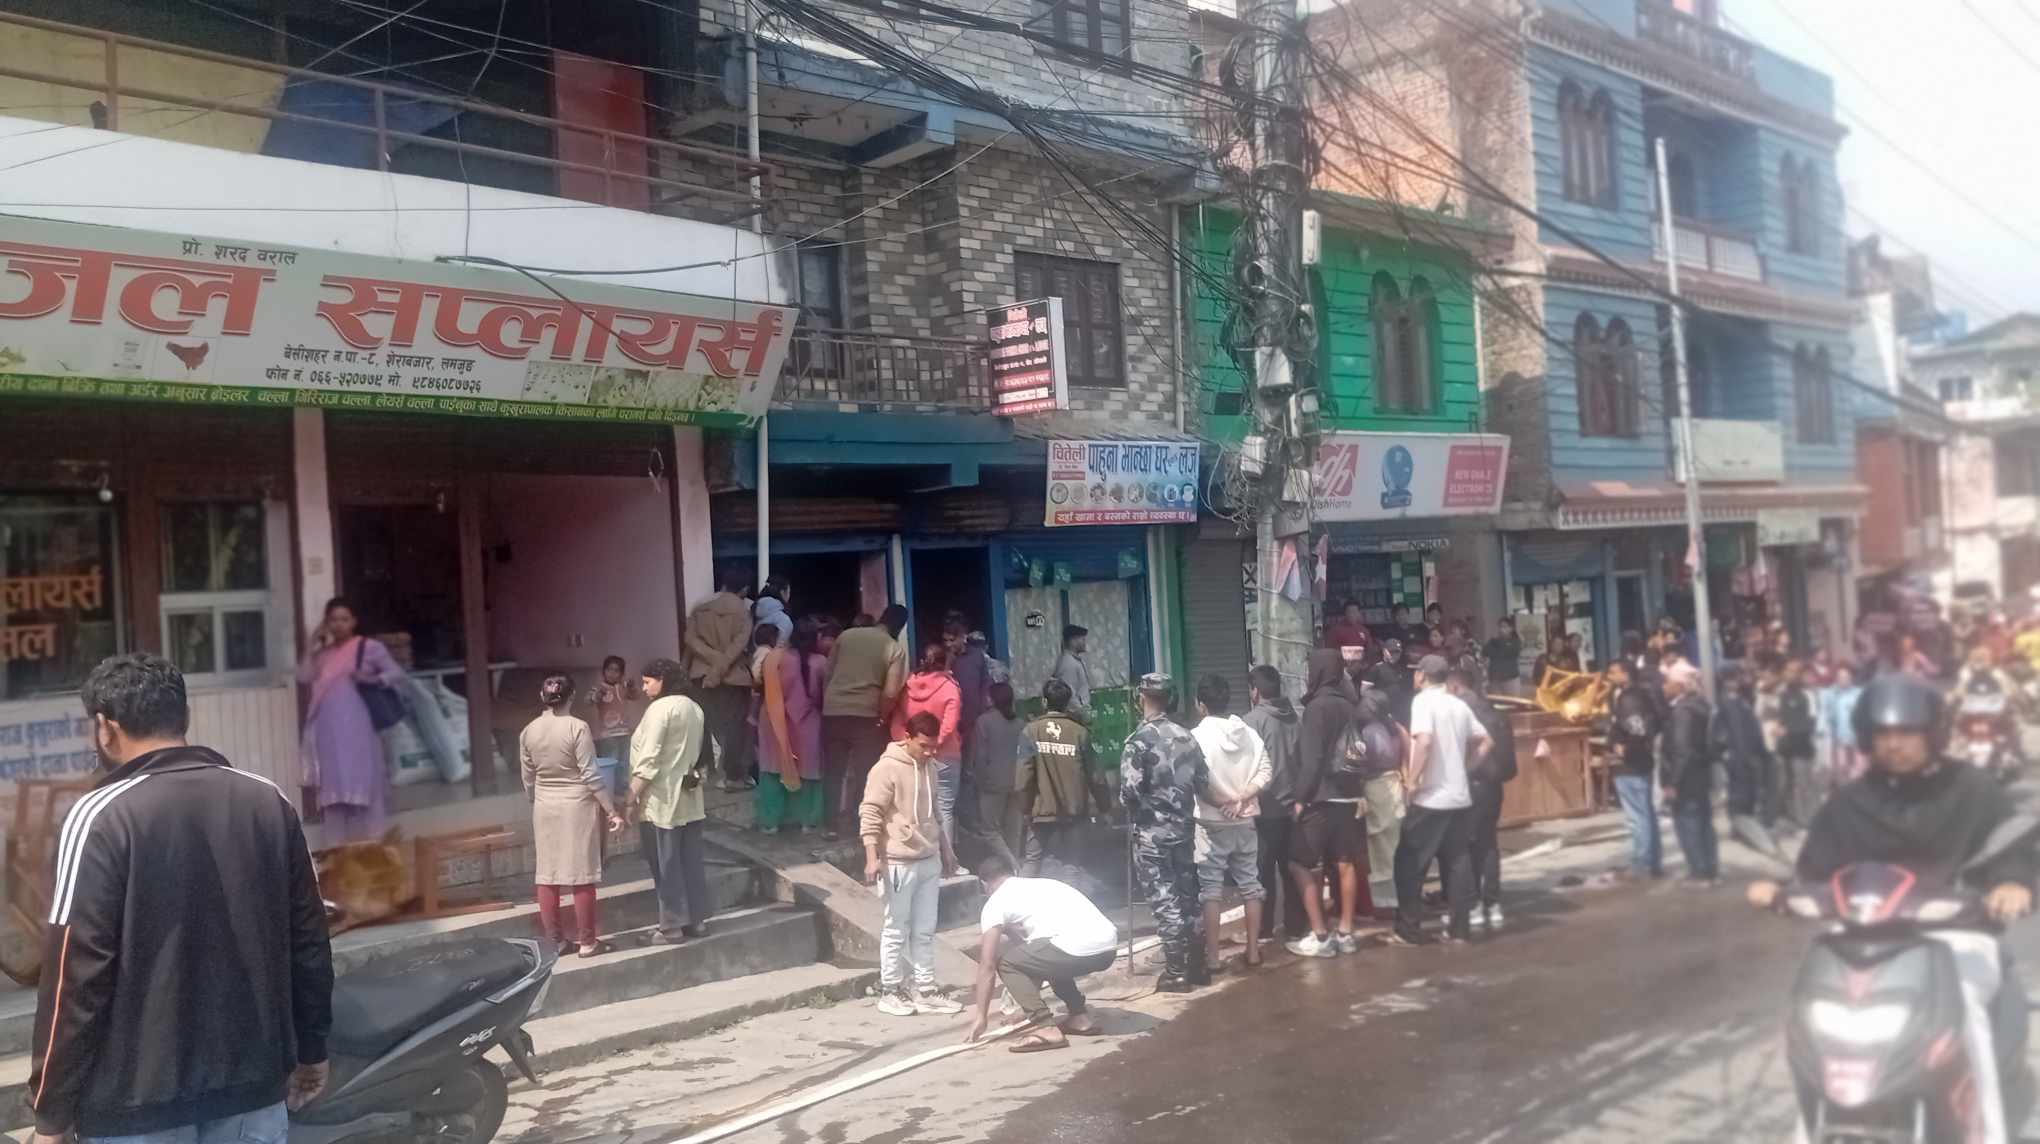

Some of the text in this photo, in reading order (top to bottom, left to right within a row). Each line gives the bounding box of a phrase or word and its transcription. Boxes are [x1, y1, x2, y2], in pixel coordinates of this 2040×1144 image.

[214, 244, 250, 263] शरद
[316, 274, 783, 378] सप्लायर्स
[264, 363, 290, 382] फोन
[1088, 444, 1118, 481] पाहुना
